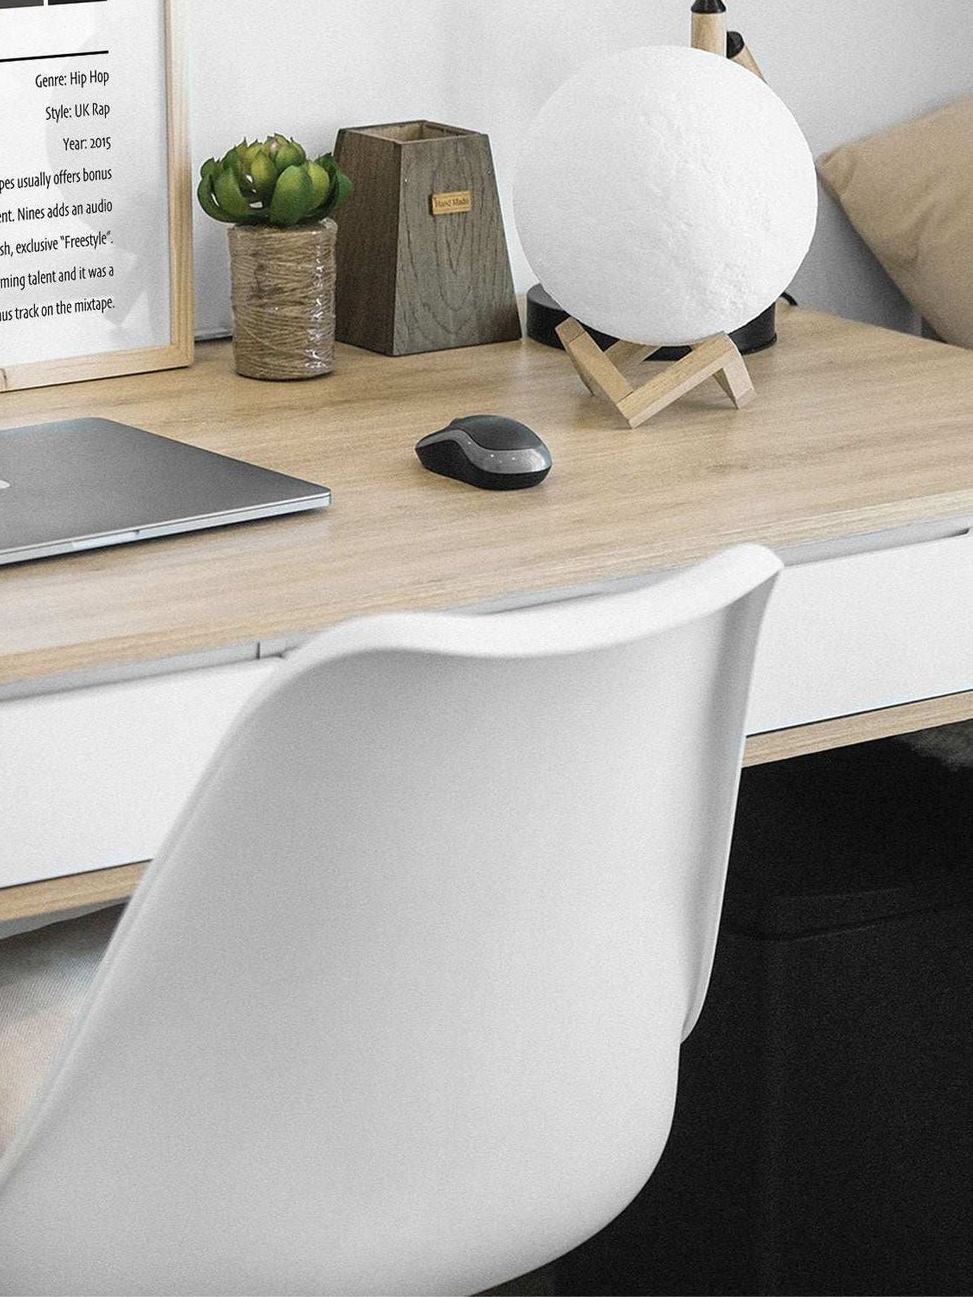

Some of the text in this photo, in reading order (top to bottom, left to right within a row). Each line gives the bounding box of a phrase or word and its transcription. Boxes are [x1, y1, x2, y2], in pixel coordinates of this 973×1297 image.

[35, 70, 109, 88] Genre: Hip Hop
[46, 103, 110, 123] Style: UK Rap
[63, 137, 111, 151] Year: 2015
[18, 172, 51, 189] usually
[54, 169, 81, 184] offers
[83, 168, 112, 181] bonus
[18, 207, 45, 221] Nines
[47, 203, 69, 218] adds
[72, 205, 83, 215] an
[86, 199, 112, 214] audio
[16, 238, 58, 253] exclusive
[28, 271, 56, 285] talent
[59, 267, 76, 282] and
[79, 267, 85, 279] it
[88, 267, 106, 278] was
[109, 266, 114, 276] a
[15, 303, 39, 319] track
[41, 305, 53, 317] on
[56, 301, 71, 314] the
[75, 299, 115, 313] mixtape.
